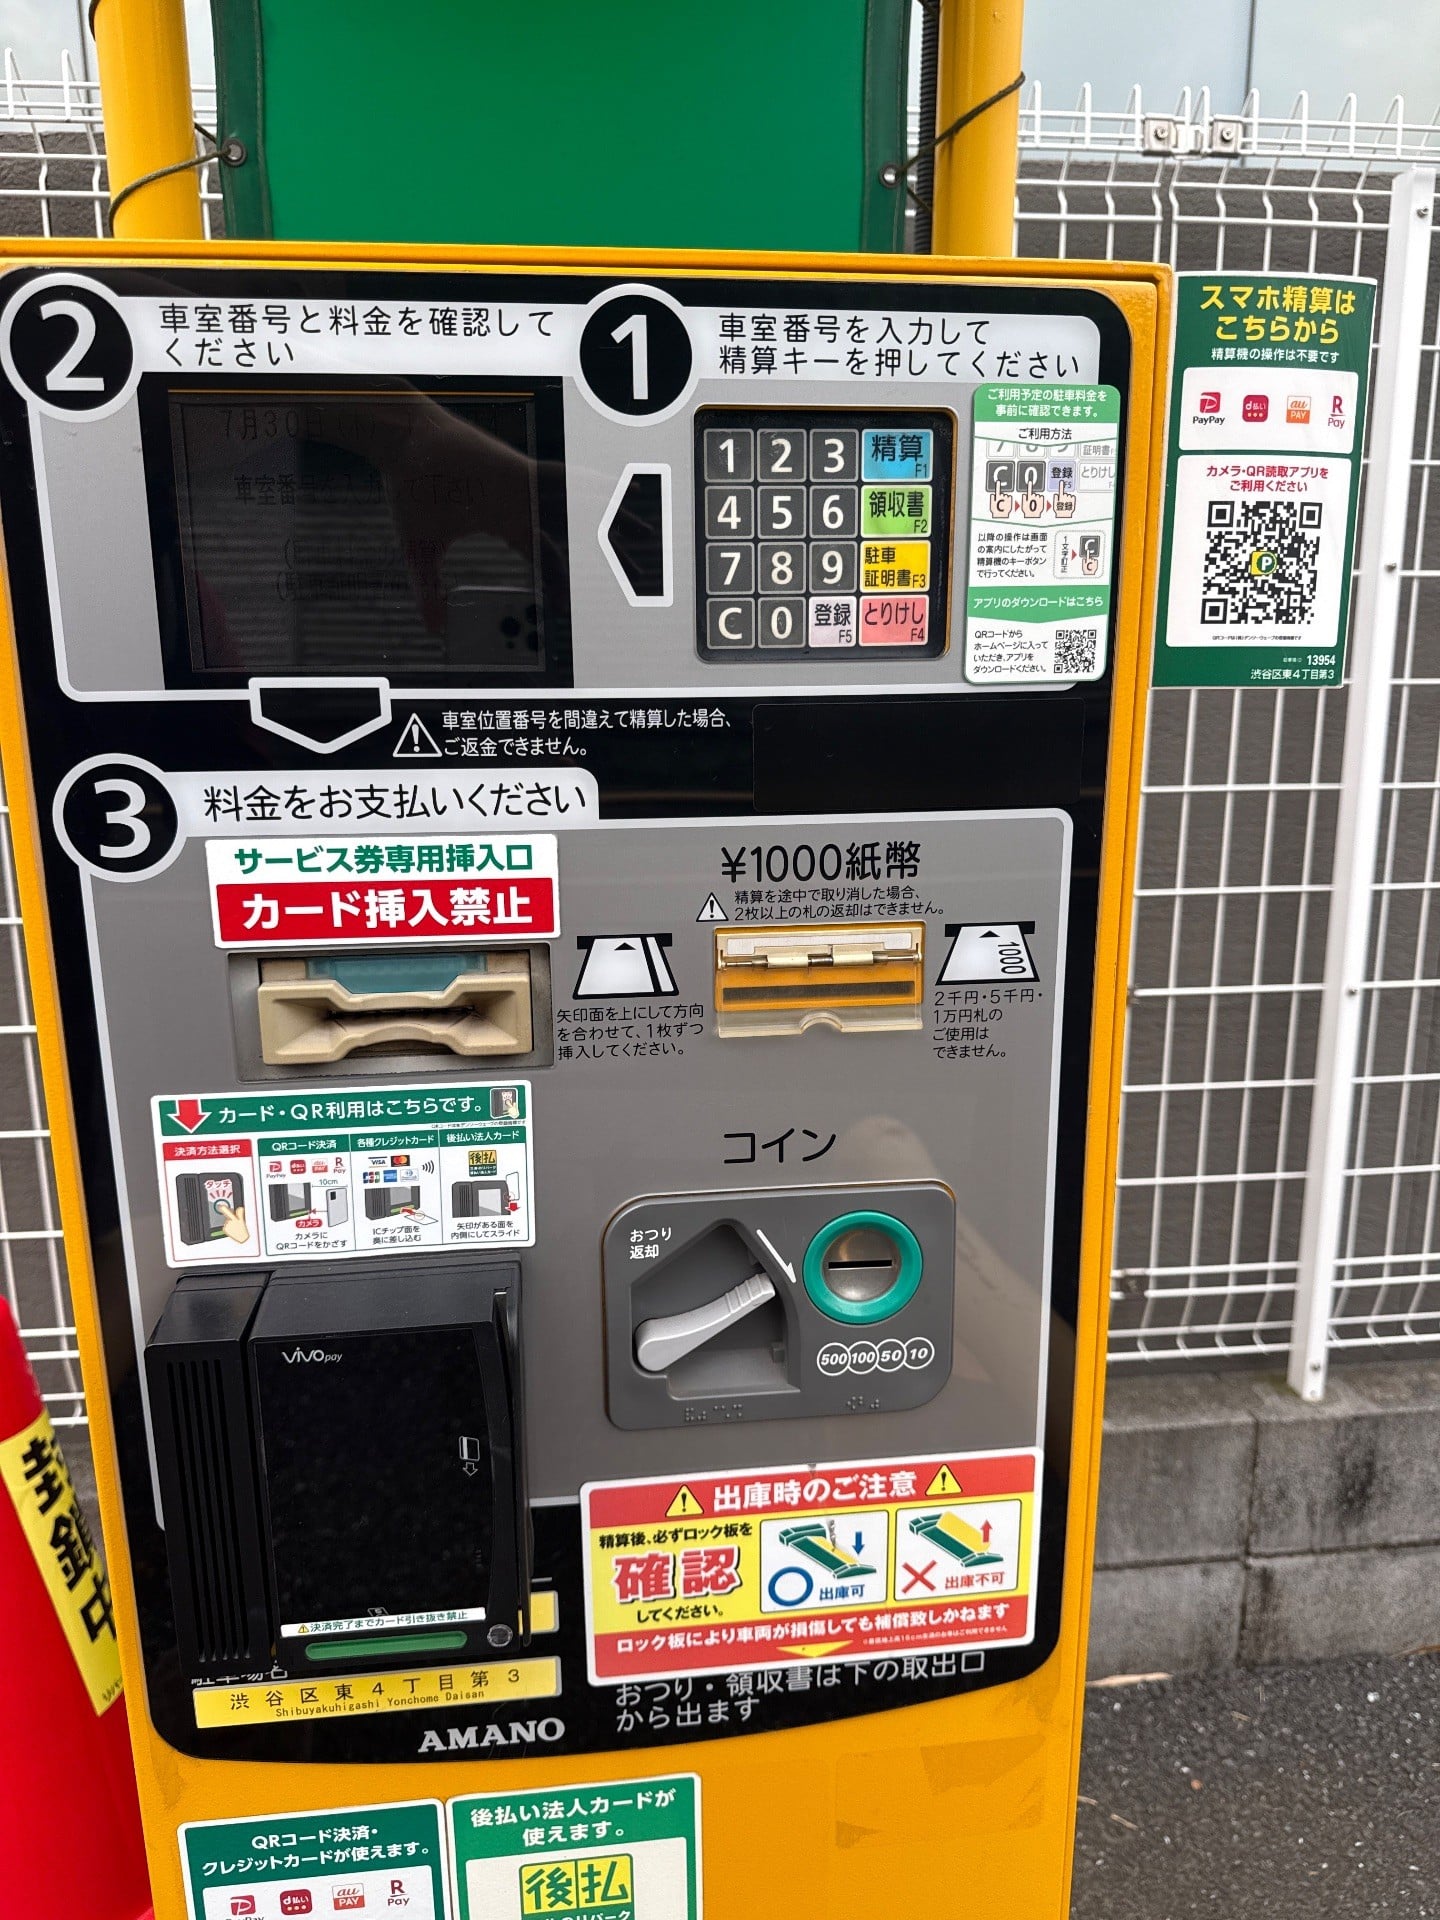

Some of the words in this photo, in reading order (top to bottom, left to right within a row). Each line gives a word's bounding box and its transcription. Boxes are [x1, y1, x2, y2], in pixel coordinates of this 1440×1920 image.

[1200, 285, 1356, 315] スマホ精算は
[159, 303, 555, 337] 車室番号と料金を確認して
[718, 313, 989, 346] 車室番号を入力して
[1215, 315, 1339, 344] こちらから
[40, 301, 104, 391] 2
[166, 338, 295, 367] ください
[610, 314, 648, 399] 1
[718, 346, 1080, 377] 精算キーを押してください
[1212, 348, 1340, 364] 精算機の操作は不要です
[987, 388, 1107, 402] ご利用予定の駐車料金を
[995, 405, 1098, 417] 事前に確認できます。
[1290, 401, 1307, 409] au
[1192, 416, 1225, 426] PayPay
[1290, 411, 1307, 420] PAY
[1328, 418, 1345, 429] Pay
[1018, 428, 1072, 440] ご利用方法
[719, 439, 734, 472] 1
[771, 439, 793, 472] 2
[823, 439, 845, 472] 3
[871, 435, 923, 462] 精算
[1083, 445, 1110, 456] 証明書
[915, 466, 928, 478] F1
[1051, 467, 1073, 478] 登録
[1206, 465, 1329, 479] カメラ・QR読取アプリを
[1230, 480, 1308, 492] ご利用ください
[717, 495, 741, 529] 4
[772, 495, 793, 529] 5
[822, 494, 844, 529] 6
[869, 491, 924, 518] 領収書
[997, 499, 1005, 512] C
[1029, 499, 1037, 511] 0
[1056, 501, 1074, 511] 登録
[914, 519, 928, 533] F2
[977, 532, 1048, 542] 以降の操作は画面
[865, 547, 896, 565] 駐車
[977, 545, 1047, 554] の案内にしたがって
[720, 552, 741, 585] 7
[771, 551, 793, 585] 8
[821, 551, 843, 584] 9
[977, 557, 1046, 566] 精算機のキーボタン
[865, 570, 911, 587] 証明書
[912, 574, 926, 588] F3
[976, 569, 1035, 578] で行ってください。
[973, 597, 1103, 609] アプリのダウンロードはこちら
[771, 606, 793, 639] 0
[814, 604, 851, 627] 登録
[865, 603, 924, 625] とりけし
[718, 607, 743, 640] C
[839, 629, 852, 643] F5
[911, 628, 924, 641] F4
[974, 630, 1023, 639] QRコードから
[974, 641, 1048, 650] ホームページに入って
[973, 653, 1034, 661] いただき、アプリを
[1306, 655, 1336, 666] 13954
[973, 665, 1047, 673] ダウンロードください。
[1250, 669, 1335, 680] 渋谷区東4丁目第3
[442, 709, 731, 730] 車室位置番号を間違えて精算した場合、
[444, 738, 587, 757] ご返金できません。
[204, 783, 587, 822] 料金をお支払いください
[93, 779, 150, 859] 3
[234, 845, 532, 874] サービス券専用挿入口
[721, 841, 921, 884] ¥1000紙幣
[735, 886, 920, 904] 精算を途中で取り消した場合、
[242, 887, 532, 929] カード挿入禁止
[735, 901, 945, 921] 2枚以上の札の返却はできません。
[997, 941, 1026, 975] 1000
[935, 989, 1043, 1006] 2千円・5千円・
[557, 1003, 704, 1023] 矢印面を上にして方向
[934, 1009, 1003, 1024] 1万円札の
[557, 1022, 703, 1041] を合わせて、1枚ずつ
[933, 1027, 989, 1041] ご使用は
[558, 1042, 684, 1060] 挿入してください。
[933, 1044, 1006, 1059] できません。
[219, 1096, 482, 1123] カード・QR利用はこちらです。
[272, 1140, 337, 1151] QRコード決済
[357, 1135, 434, 1148] 各種クレジットカード
[446, 1130, 520, 1143] 後払い法人カード
[723, 1128, 837, 1163] コイン
[174, 1145, 240, 1156] 決済方法選択
[470, 1152, 495, 1164] 後払
[205, 1179, 231, 1188] タッチ
[373, 1225, 420, 1235] ICチップ面を
[457, 1220, 513, 1230] 矢印がある面を
[295, 1232, 328, 1240] カメラに
[372, 1235, 421, 1245] 奥に差し込む
[451, 1230, 520, 1239] 内側にしてスライド
[629, 1227, 672, 1243] おつり
[276, 1240, 347, 1250] QRコードをかざす
[629, 1244, 660, 1260] 返却
[821, 1353, 847, 1366] 500
[851, 1352, 875, 1364] 100
[880, 1349, 902, 1362] 50
[909, 1347, 928, 1361] 10
[713, 1471, 917, 1512] 出庫時のご注意
[599, 1523, 752, 1549] 精算後、必ずロック板を
[615, 1547, 741, 1603] 確認
[945, 1572, 1005, 1589] 出庫不可
[819, 1584, 865, 1601] 出庫可
[311, 1611, 467, 1632] 決済完了までカード引き抜き禁止
[637, 1604, 723, 1623] してください。
[617, 1603, 1009, 1653] ロック板により車両が損傷しても補償致しかねます
[616, 1651, 985, 1706] おつり・領収書は下の取出口
[276, 1700, 380, 1718] Shibuyakuhigashi
[387, 1694, 439, 1708] Yonchome
[445, 1691, 484, 1701] Daisan
[617, 1697, 760, 1733] から出ます
[418, 1717, 566, 1753] AMANO
[470, 1788, 676, 1828] 後払い法人カードが
[252, 1826, 378, 1850] QRコード決済・
[523, 1820, 624, 1847] 使えます。
[203, 1841, 429, 1877] クレジットカードが使えます。
[337, 1887, 360, 1897] au
[525, 1861, 629, 1910] 後払
[339, 1897, 359, 1906] PAY
[388, 1896, 409, 1907] Pay
